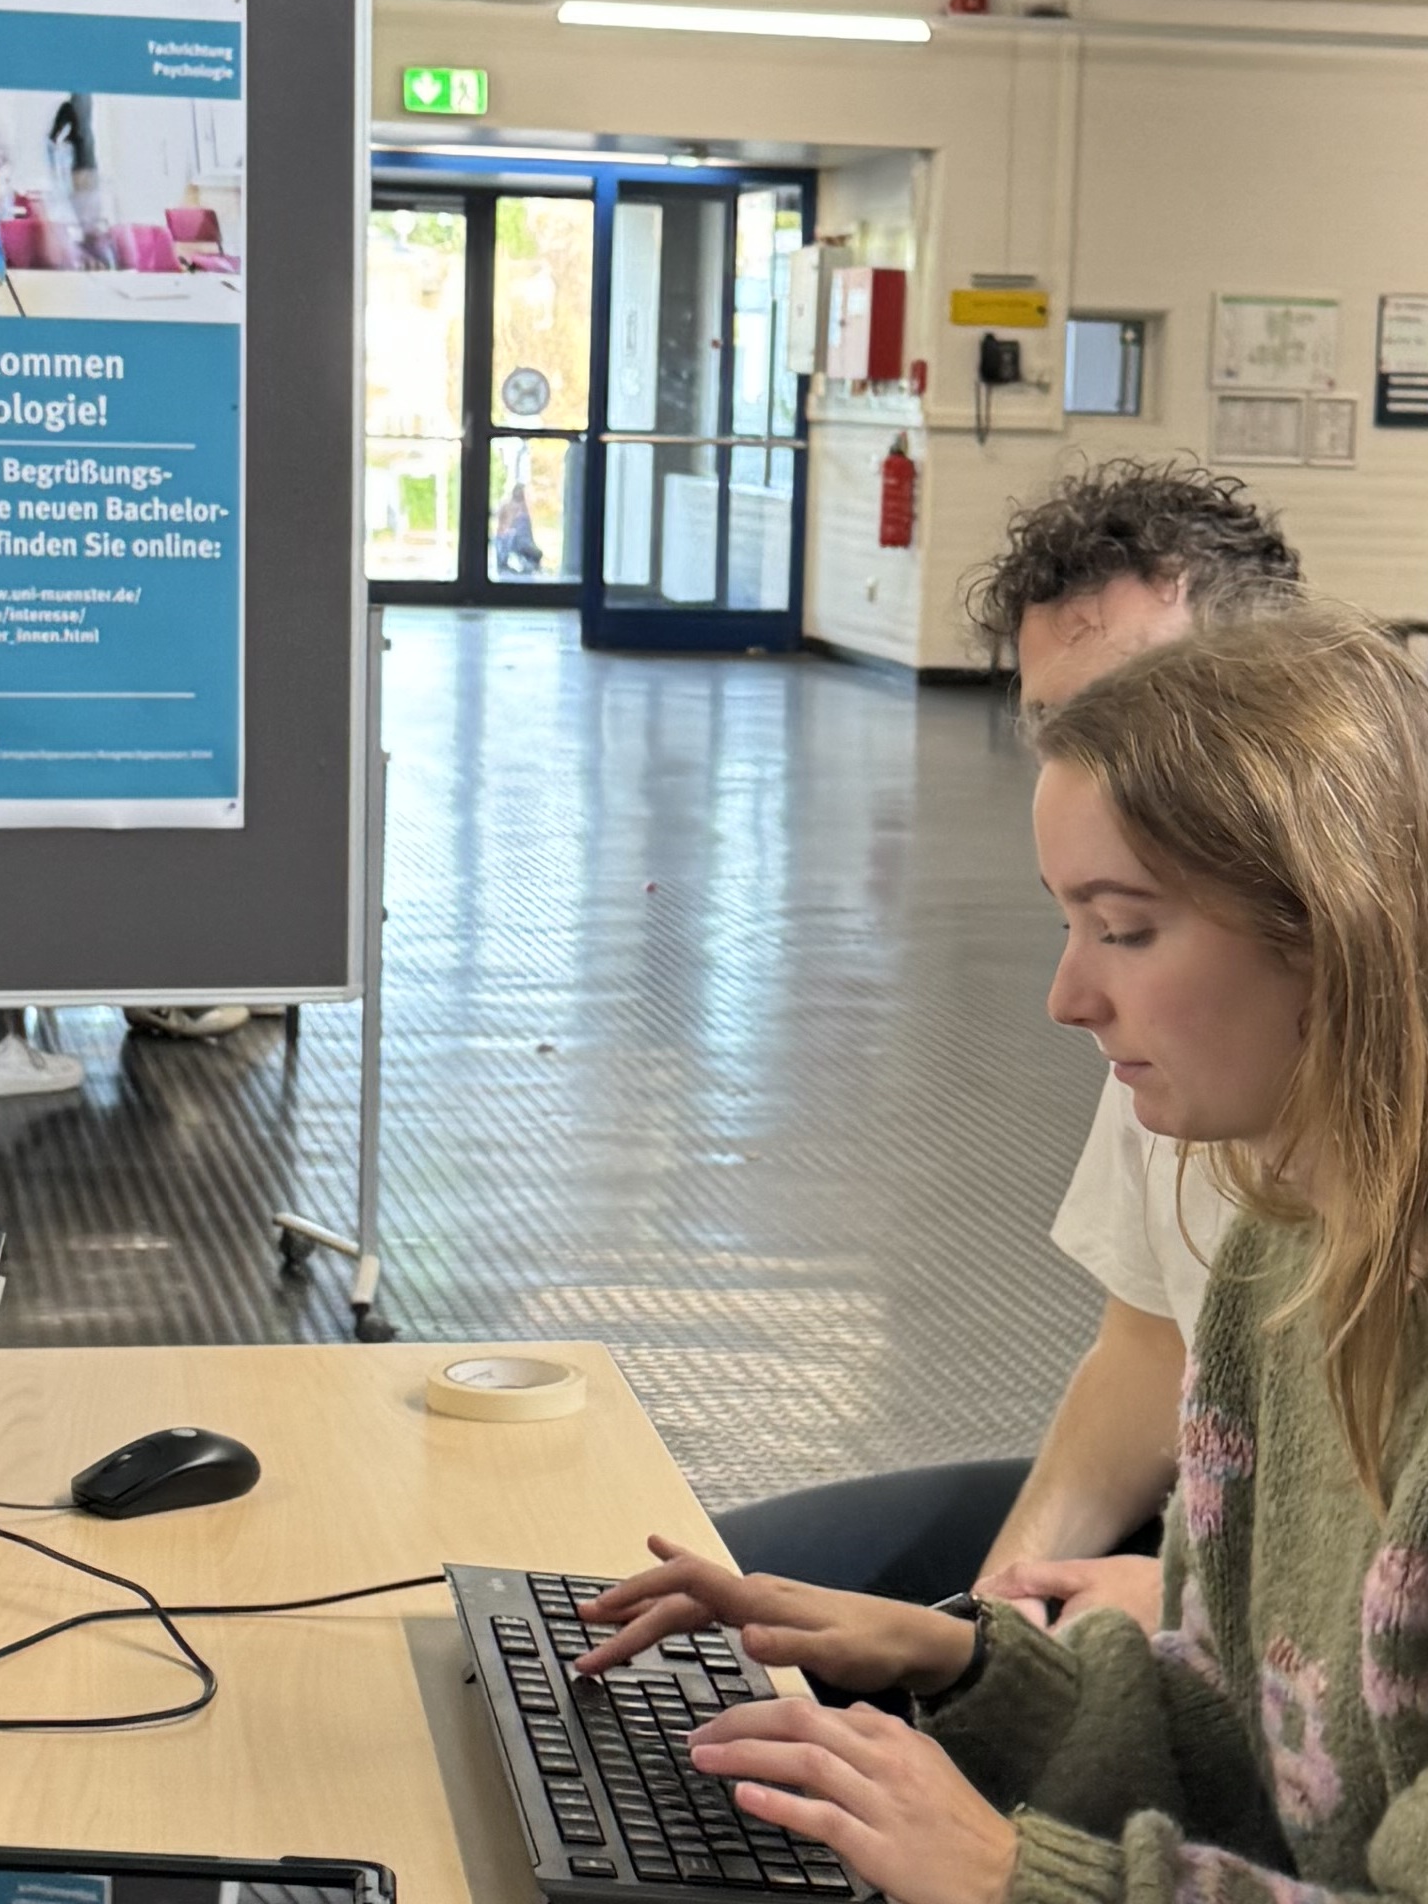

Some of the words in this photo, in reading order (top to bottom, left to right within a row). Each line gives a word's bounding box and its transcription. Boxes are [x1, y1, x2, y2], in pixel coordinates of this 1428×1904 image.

[153, 61, 234, 81] Psychologie
[2, 457, 172, 490] Begrüßungs-
[18, 499, 98, 521] neuen
[106, 496, 228, 522] Bachelor-
[85, 532, 125, 557] Sie
[132, 532, 221, 558] online:
